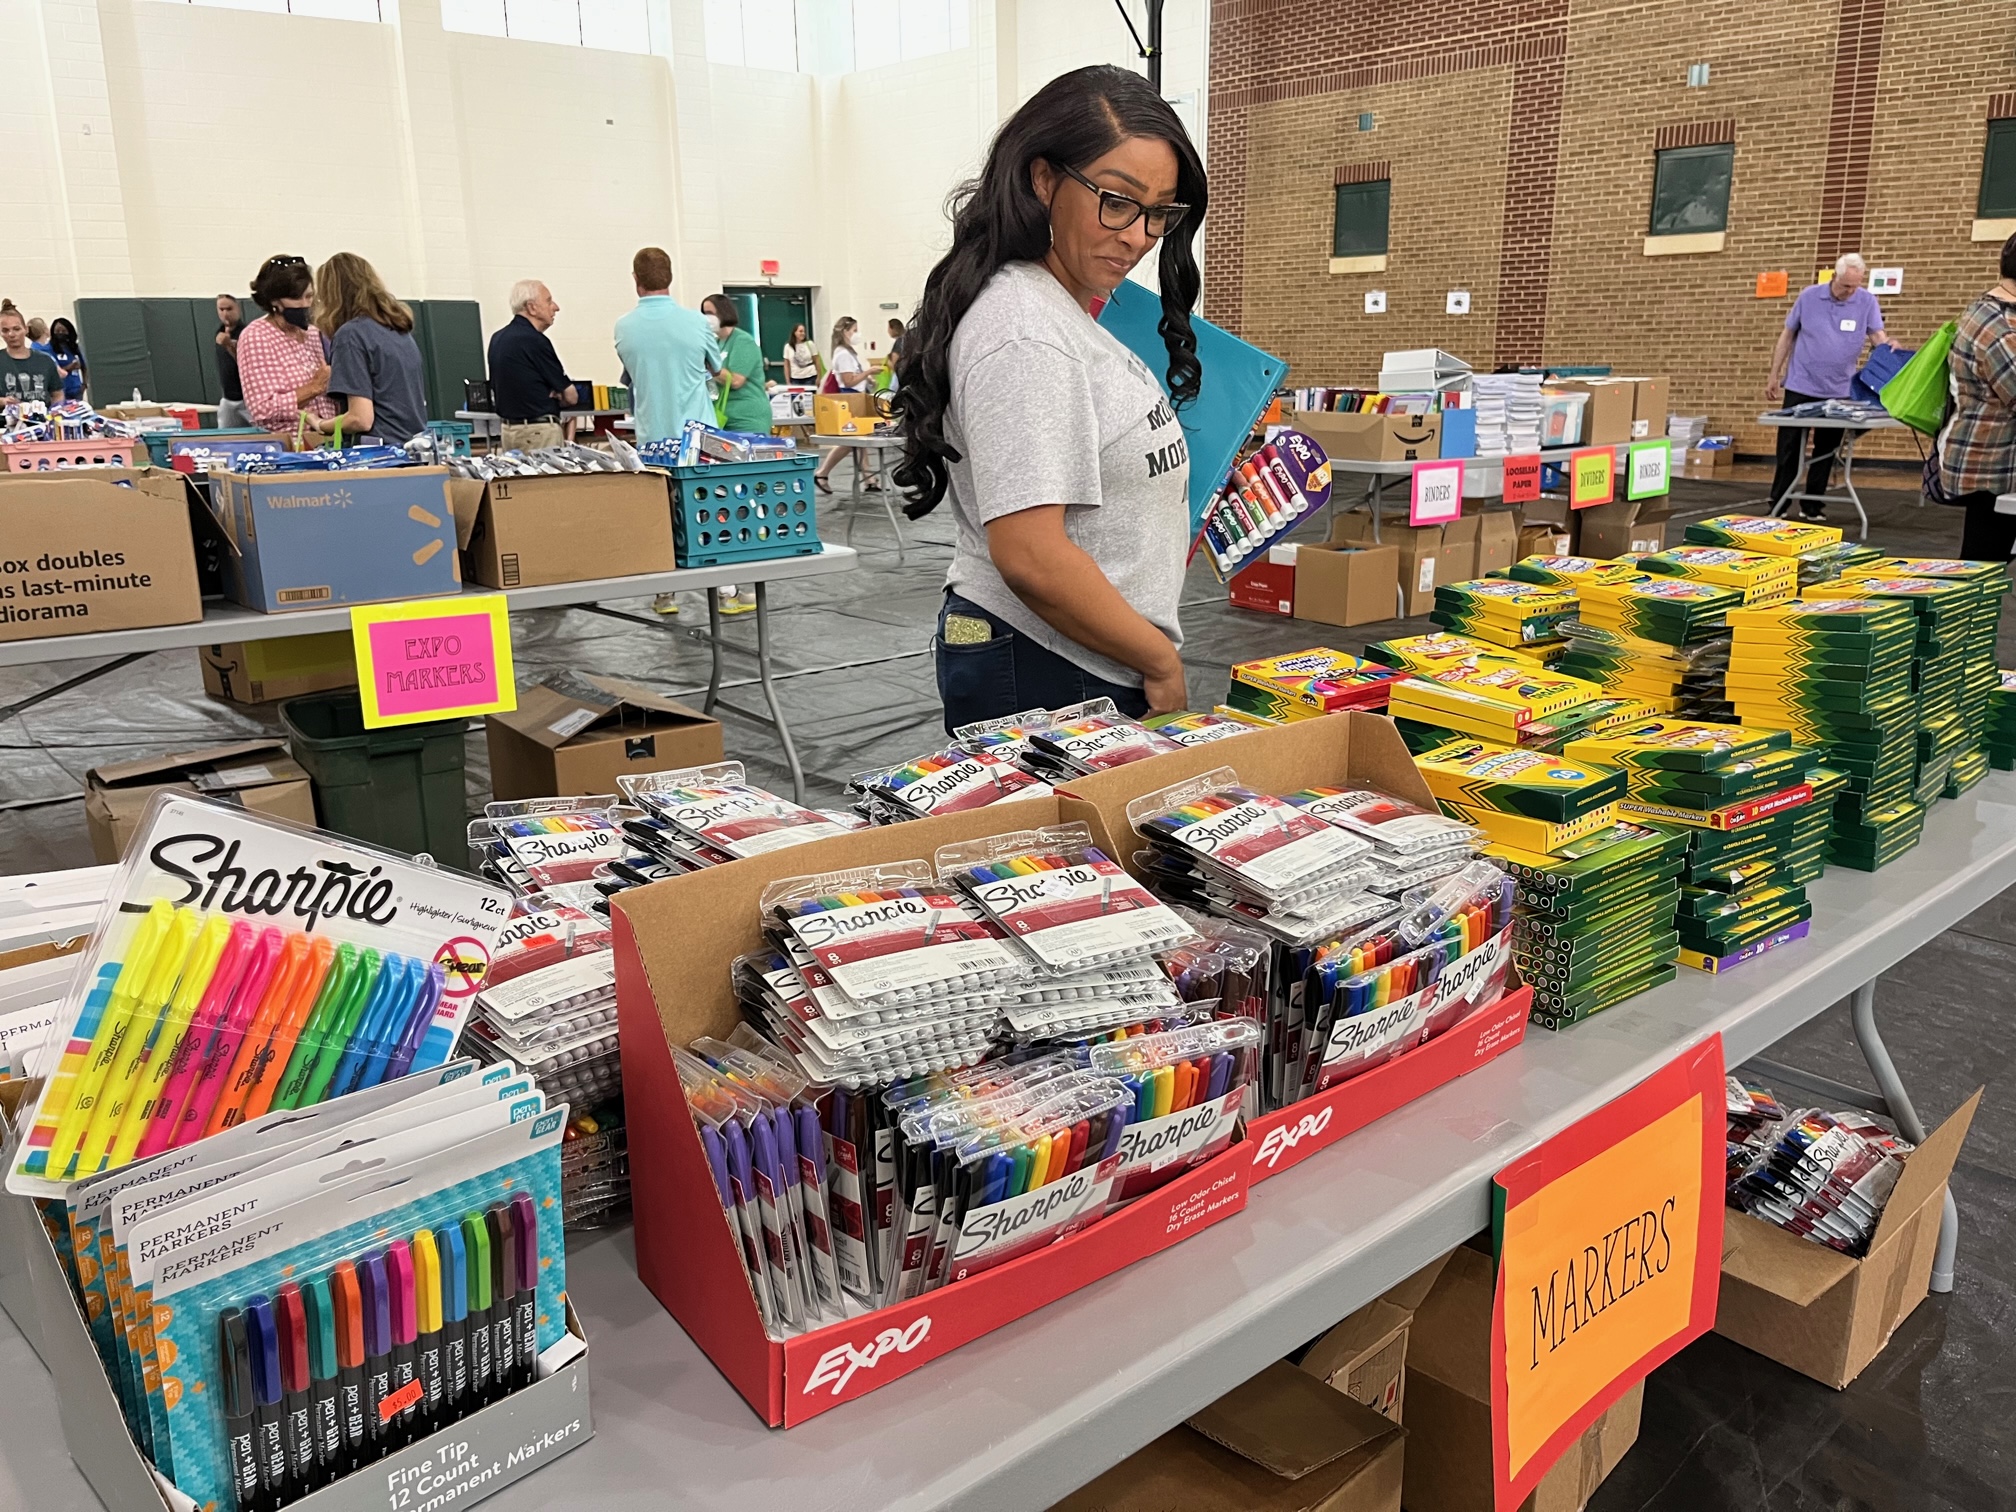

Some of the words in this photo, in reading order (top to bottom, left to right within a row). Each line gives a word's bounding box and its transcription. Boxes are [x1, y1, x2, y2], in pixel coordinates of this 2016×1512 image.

[1289, 435, 1311, 460] EXPO
[1274, 465, 1288, 483] EXPO
[1513, 480, 1531, 489] PAPER
[1580, 470, 1605, 487] DIVIDERS
[267, 494, 331, 509] Walmart
[1425, 485, 1450, 502] BINDERS
[1223, 508, 1236, 525] EXPO
[1231, 502, 1244, 519] EXPO
[1212, 516, 1225, 532] EXPO
[0, 560, 29, 573] ox
[36, 550, 125, 571] doubles
[22, 573, 151, 597] last-minute
[0, 603, 89, 623] diorama
[405, 635, 462, 660] EXPO
[387, 662, 486, 693] MARKERS
[1241, 673, 1258, 683] SUPER
[907, 761, 984, 810] Sharpie
[1552, 769, 1579, 780] 20
[1620, 803, 1643, 812] SUPER
[1644, 806, 1677, 817] Washable
[1678, 812, 1706, 822] Markers
[1752, 806, 1758, 816] 10
[1759, 802, 1774, 812] SUPER
[1185, 805, 1267, 852] Sharpie
[119, 834, 398, 932] Sharpie
[799, 900, 926, 949] Sharpie
[1016, 920, 1026, 929] 8
[827, 953, 839, 961] 8
[1322, 999, 1414, 1064] Sharpie
[1422, 1028, 1428, 1036] 8
[1480, 1030, 1490, 1038] Low
[1492, 1021, 1504, 1032] Odor
[1506, 1009, 1521, 1024] Chisel
[100, 1021, 126, 1066] Sharpie
[1474, 1048, 1485, 1056] Dry
[1486, 1040, 1499, 1050] Erase
[1500, 1027, 1520, 1042] Markers
[1484, 1030, 1500, 1043] Count
[1322, 1075, 1330, 1085] 8
[536, 1121, 556, 1135] GEAR
[1252, 1105, 1333, 1168] EXPO
[86, 1154, 197, 1204] PERMANENT
[122, 1171, 241, 1215] PERMANENT
[1171, 1199, 1187, 1213] Low
[1190, 1187, 1210, 1202] Odor
[1212, 1172, 1236, 1191] Chisel
[955, 1174, 1088, 1257] Sharpie
[1166, 1221, 1182, 1234] Dry
[1183, 1210, 1205, 1225] Erase
[1207, 1192, 1239, 1213] Markers
[1169, 1212, 1178, 1223] 16
[1180, 1199, 1205, 1217] Count
[82, 1231, 91, 1241] 12
[140, 1199, 258, 1252] PERMANENT
[140, 1220, 232, 1262] MARKERS
[163, 1222, 284, 1276] PERMANENT
[162, 1242, 256, 1283] MARKERS
[912, 1250, 921, 1260] 8
[957, 1269, 967, 1280] 8
[1530, 1196, 1676, 1371] MARKERS
[161, 1311, 170, 1322] 12
[803, 1315, 931, 1394] EXPO
[392, 1389, 417, 1410] $5.00
[507, 1418, 580, 1468] Markers
[387, 1459, 432, 1491] Fine
[437, 1441, 469, 1465] Tip
[388, 1488, 410, 1511] 12
[417, 1454, 479, 1495] Count
